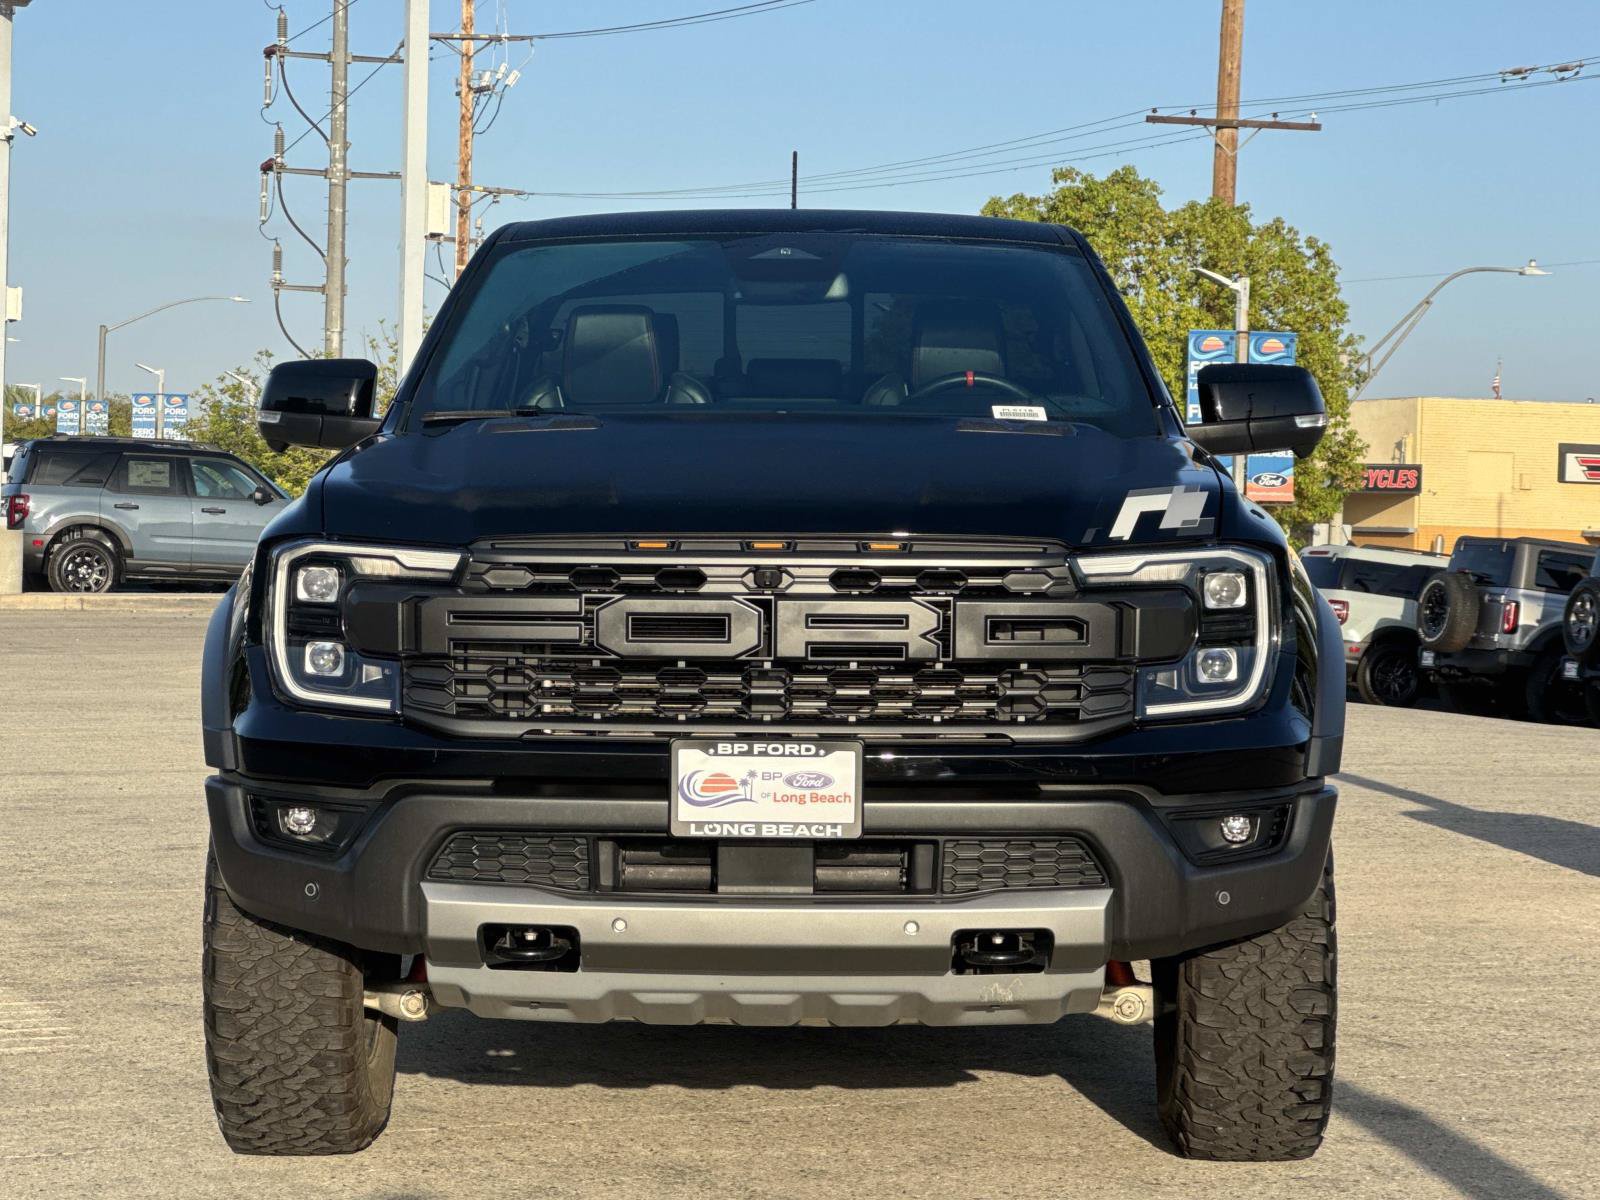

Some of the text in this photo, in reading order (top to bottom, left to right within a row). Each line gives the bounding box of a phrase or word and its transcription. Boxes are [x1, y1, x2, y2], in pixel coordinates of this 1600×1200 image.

[132, 407, 156, 415] FORD
[420, 597, 1120, 659] FORD
[717, 743, 817, 756] BP FORD
[761, 771, 825, 788] BP Ford
[773, 792, 807, 804] Long
[809, 792, 852, 804] Beach
[689, 822, 843, 837] LONG BEACH
